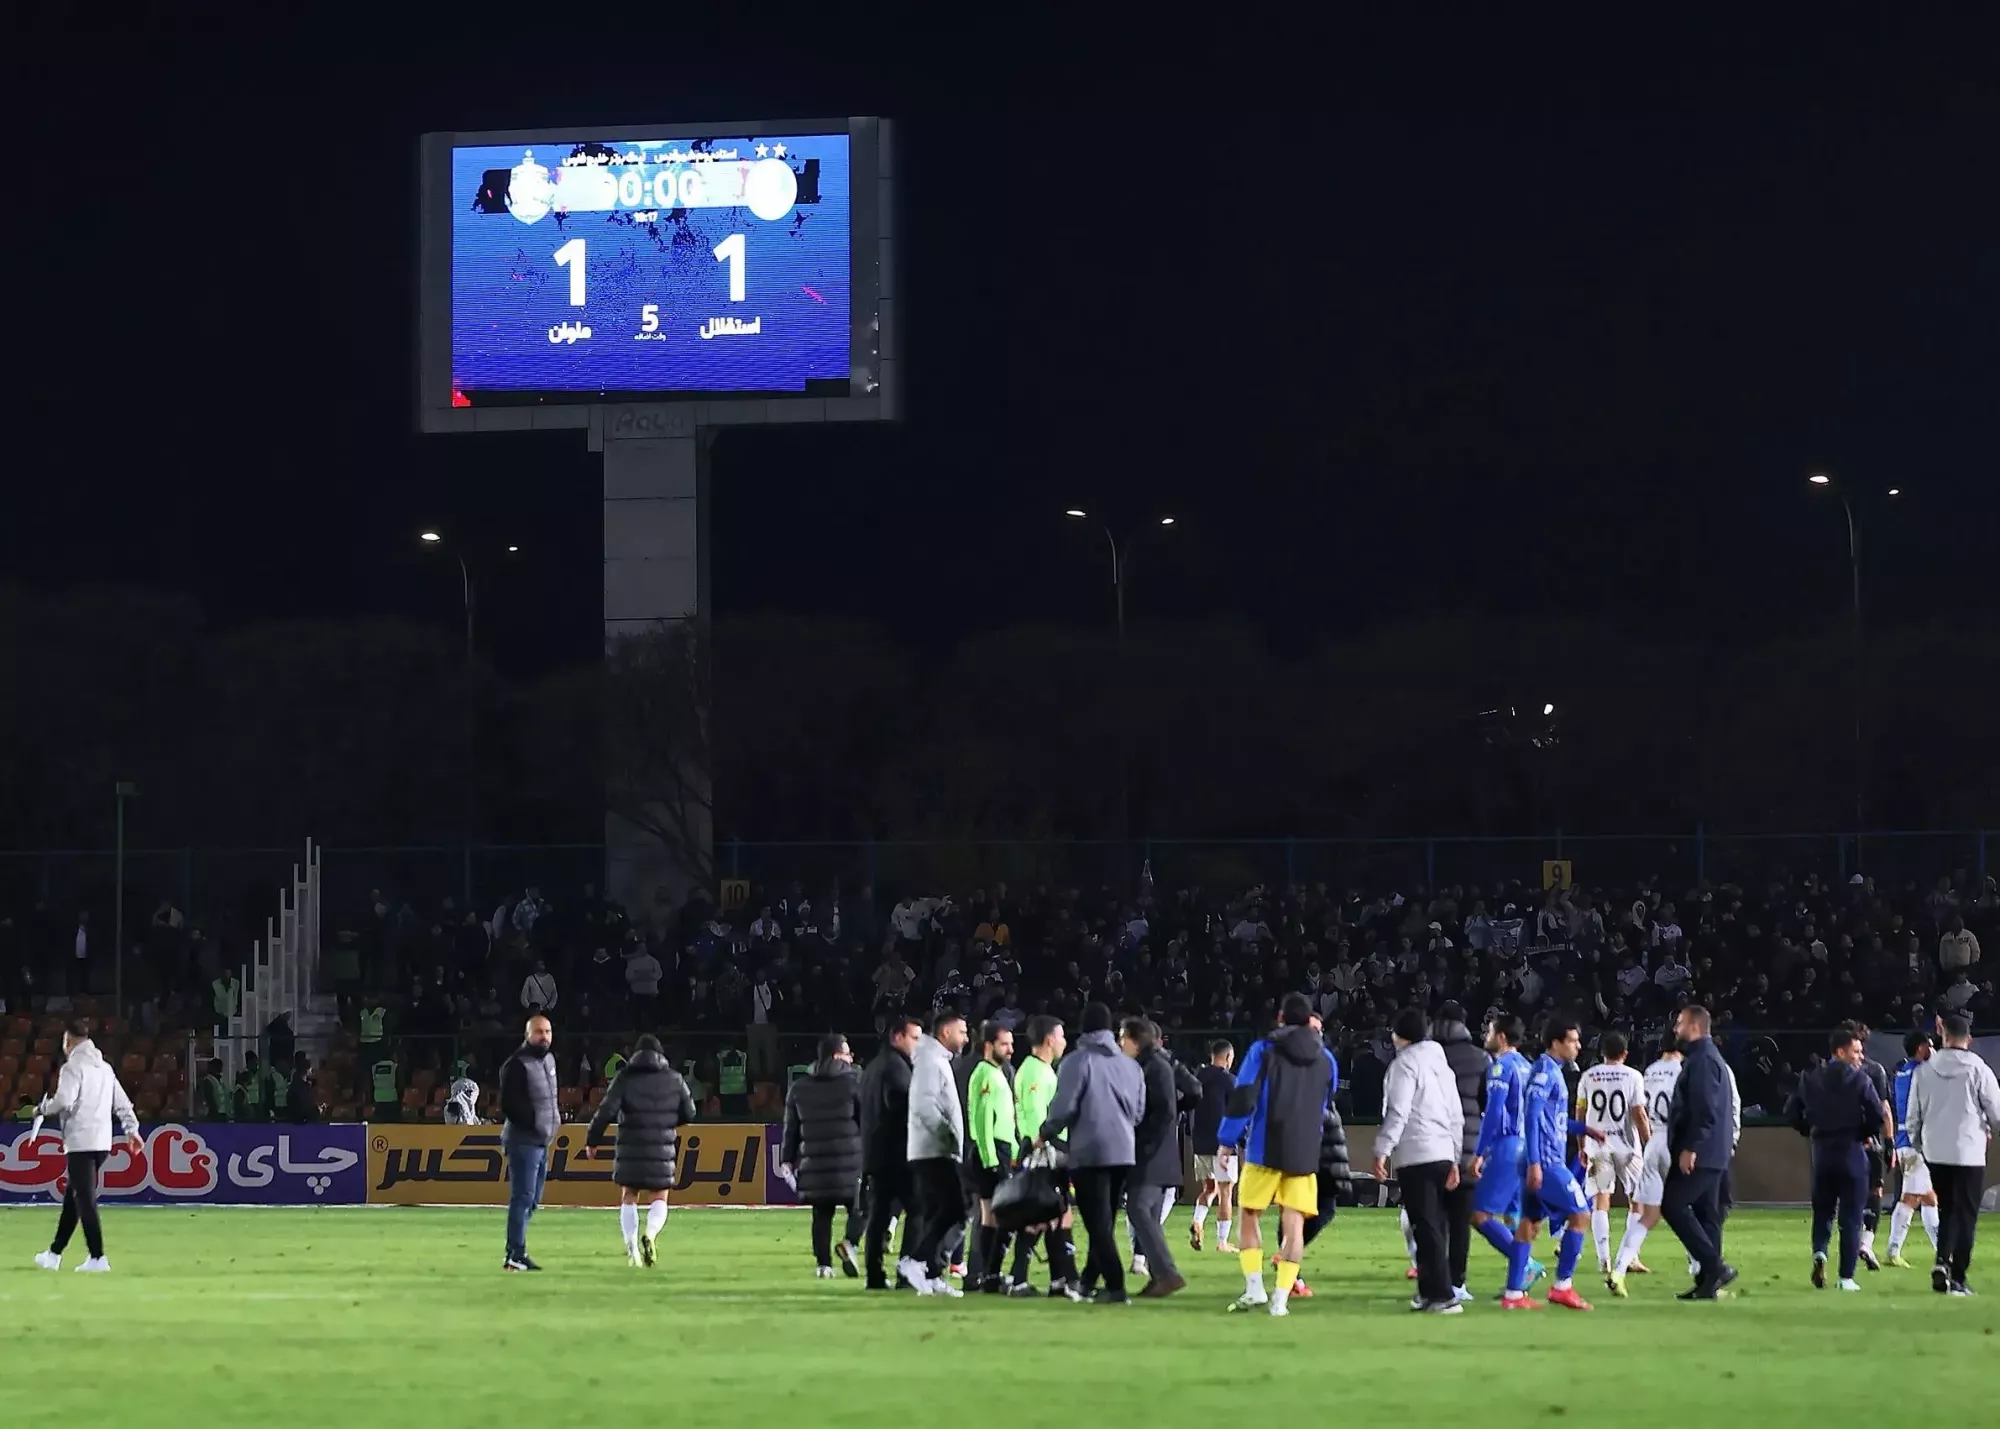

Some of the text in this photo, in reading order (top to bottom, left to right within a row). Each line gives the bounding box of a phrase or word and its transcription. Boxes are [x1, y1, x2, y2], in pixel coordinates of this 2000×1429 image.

[553, 238, 586, 306] 1
[712, 234, 746, 301] 1
[548, 321, 592, 344] ملوان
[642, 304, 659, 332] 5
[700, 316, 760, 339] استقلال
[1552, 864, 1562, 883] 9
[1591, 1089, 1626, 1122] 90
[0, 1130, 358, 1195] چای نادی
[672, 1135, 761, 1196] ابز
